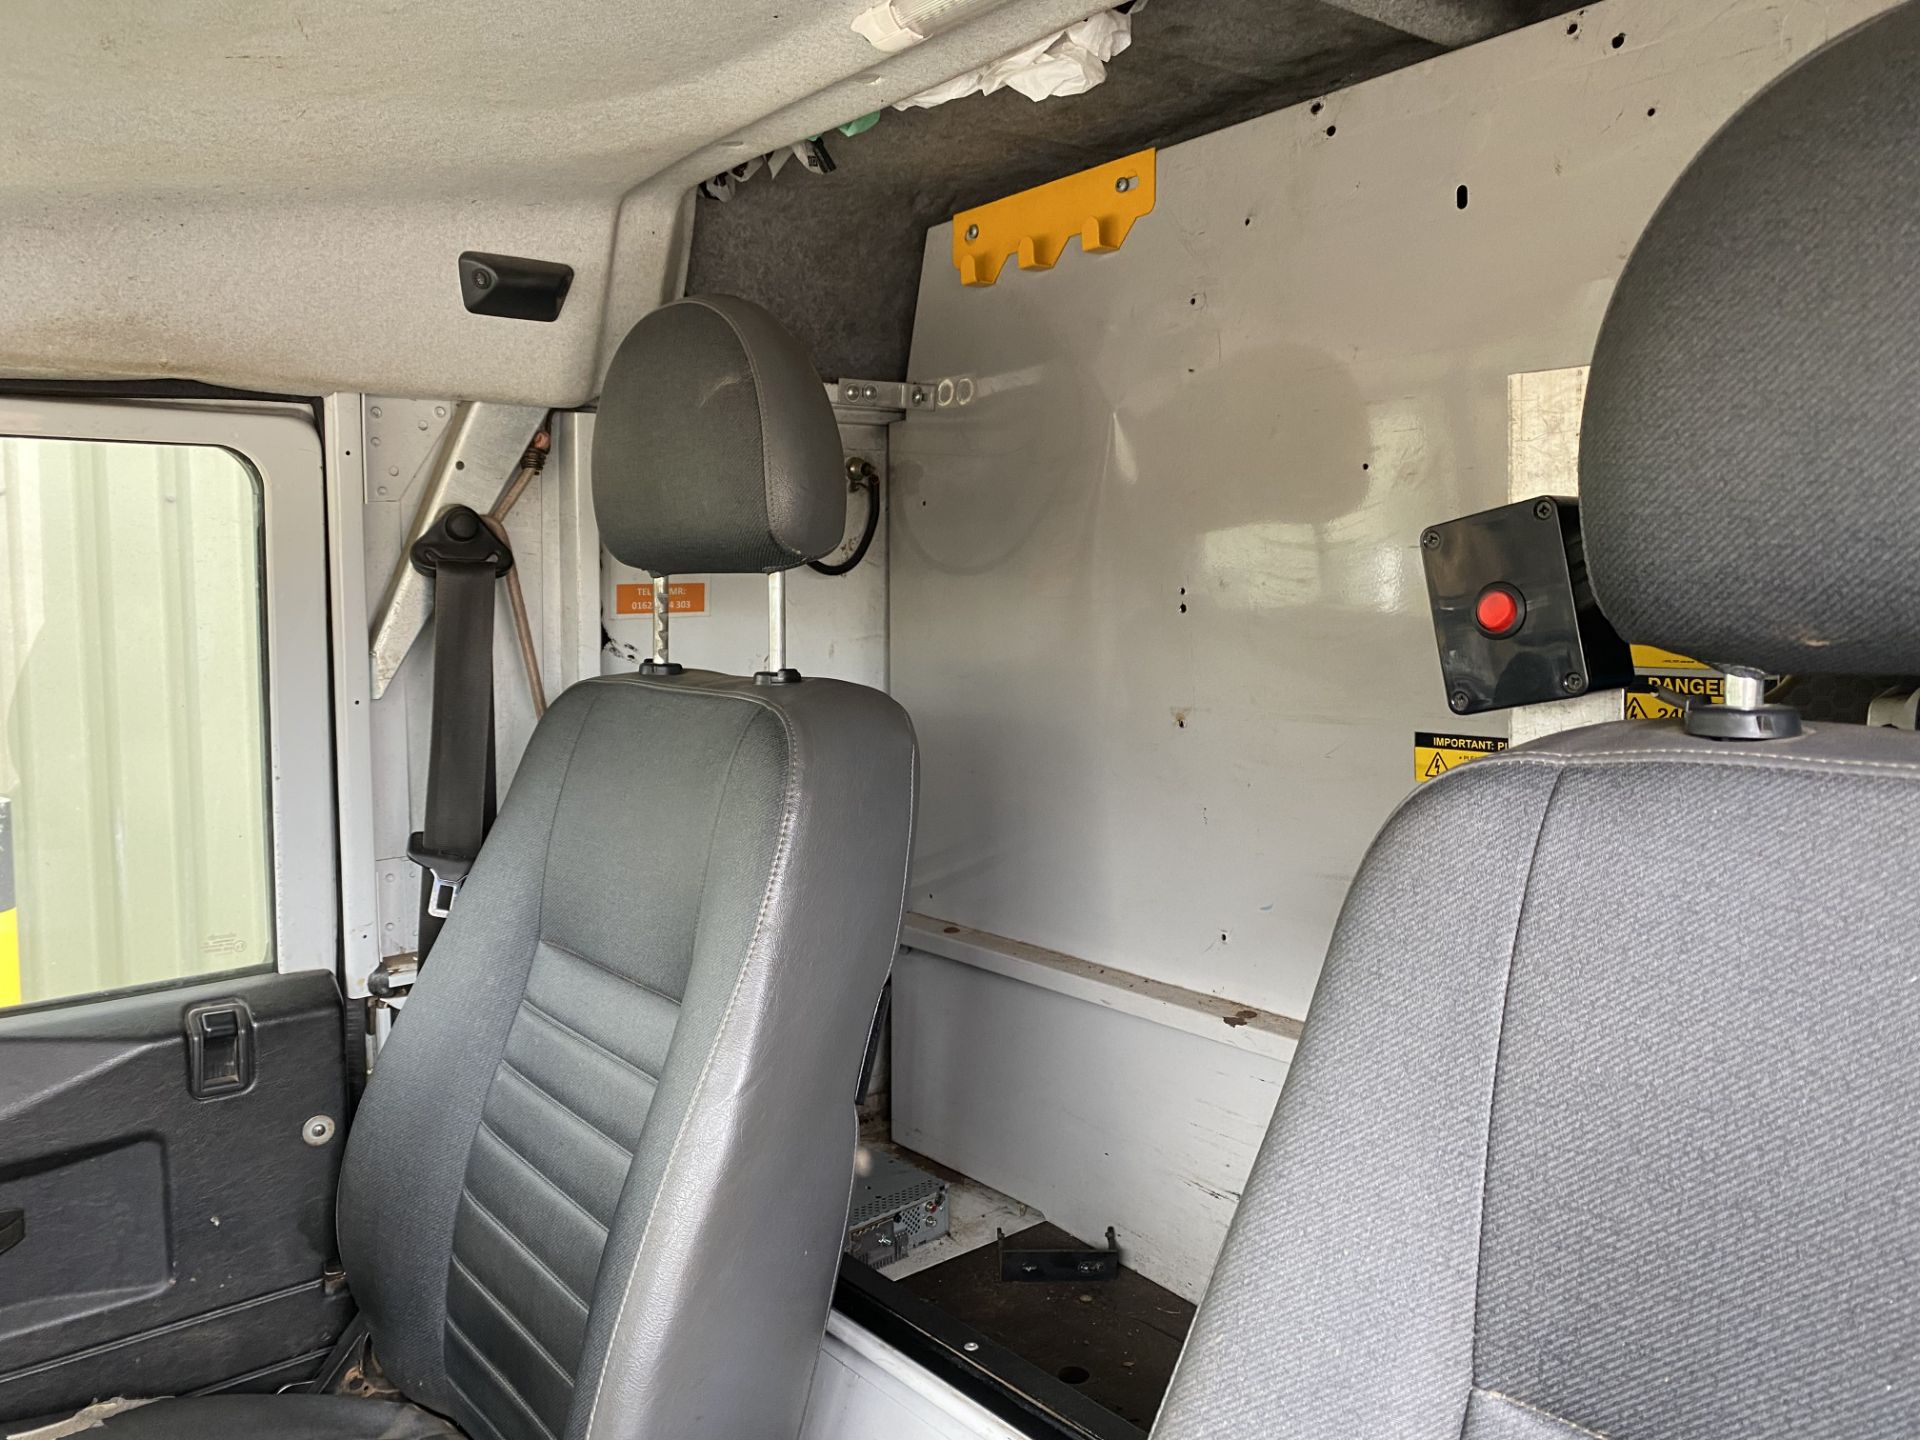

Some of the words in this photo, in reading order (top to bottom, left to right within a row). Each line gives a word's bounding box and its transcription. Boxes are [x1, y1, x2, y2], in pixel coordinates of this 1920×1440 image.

[631, 601, 653, 610] 0162
[675, 600, 691, 608] 303
[1433, 736, 1495, 751] IMPORTANT:
